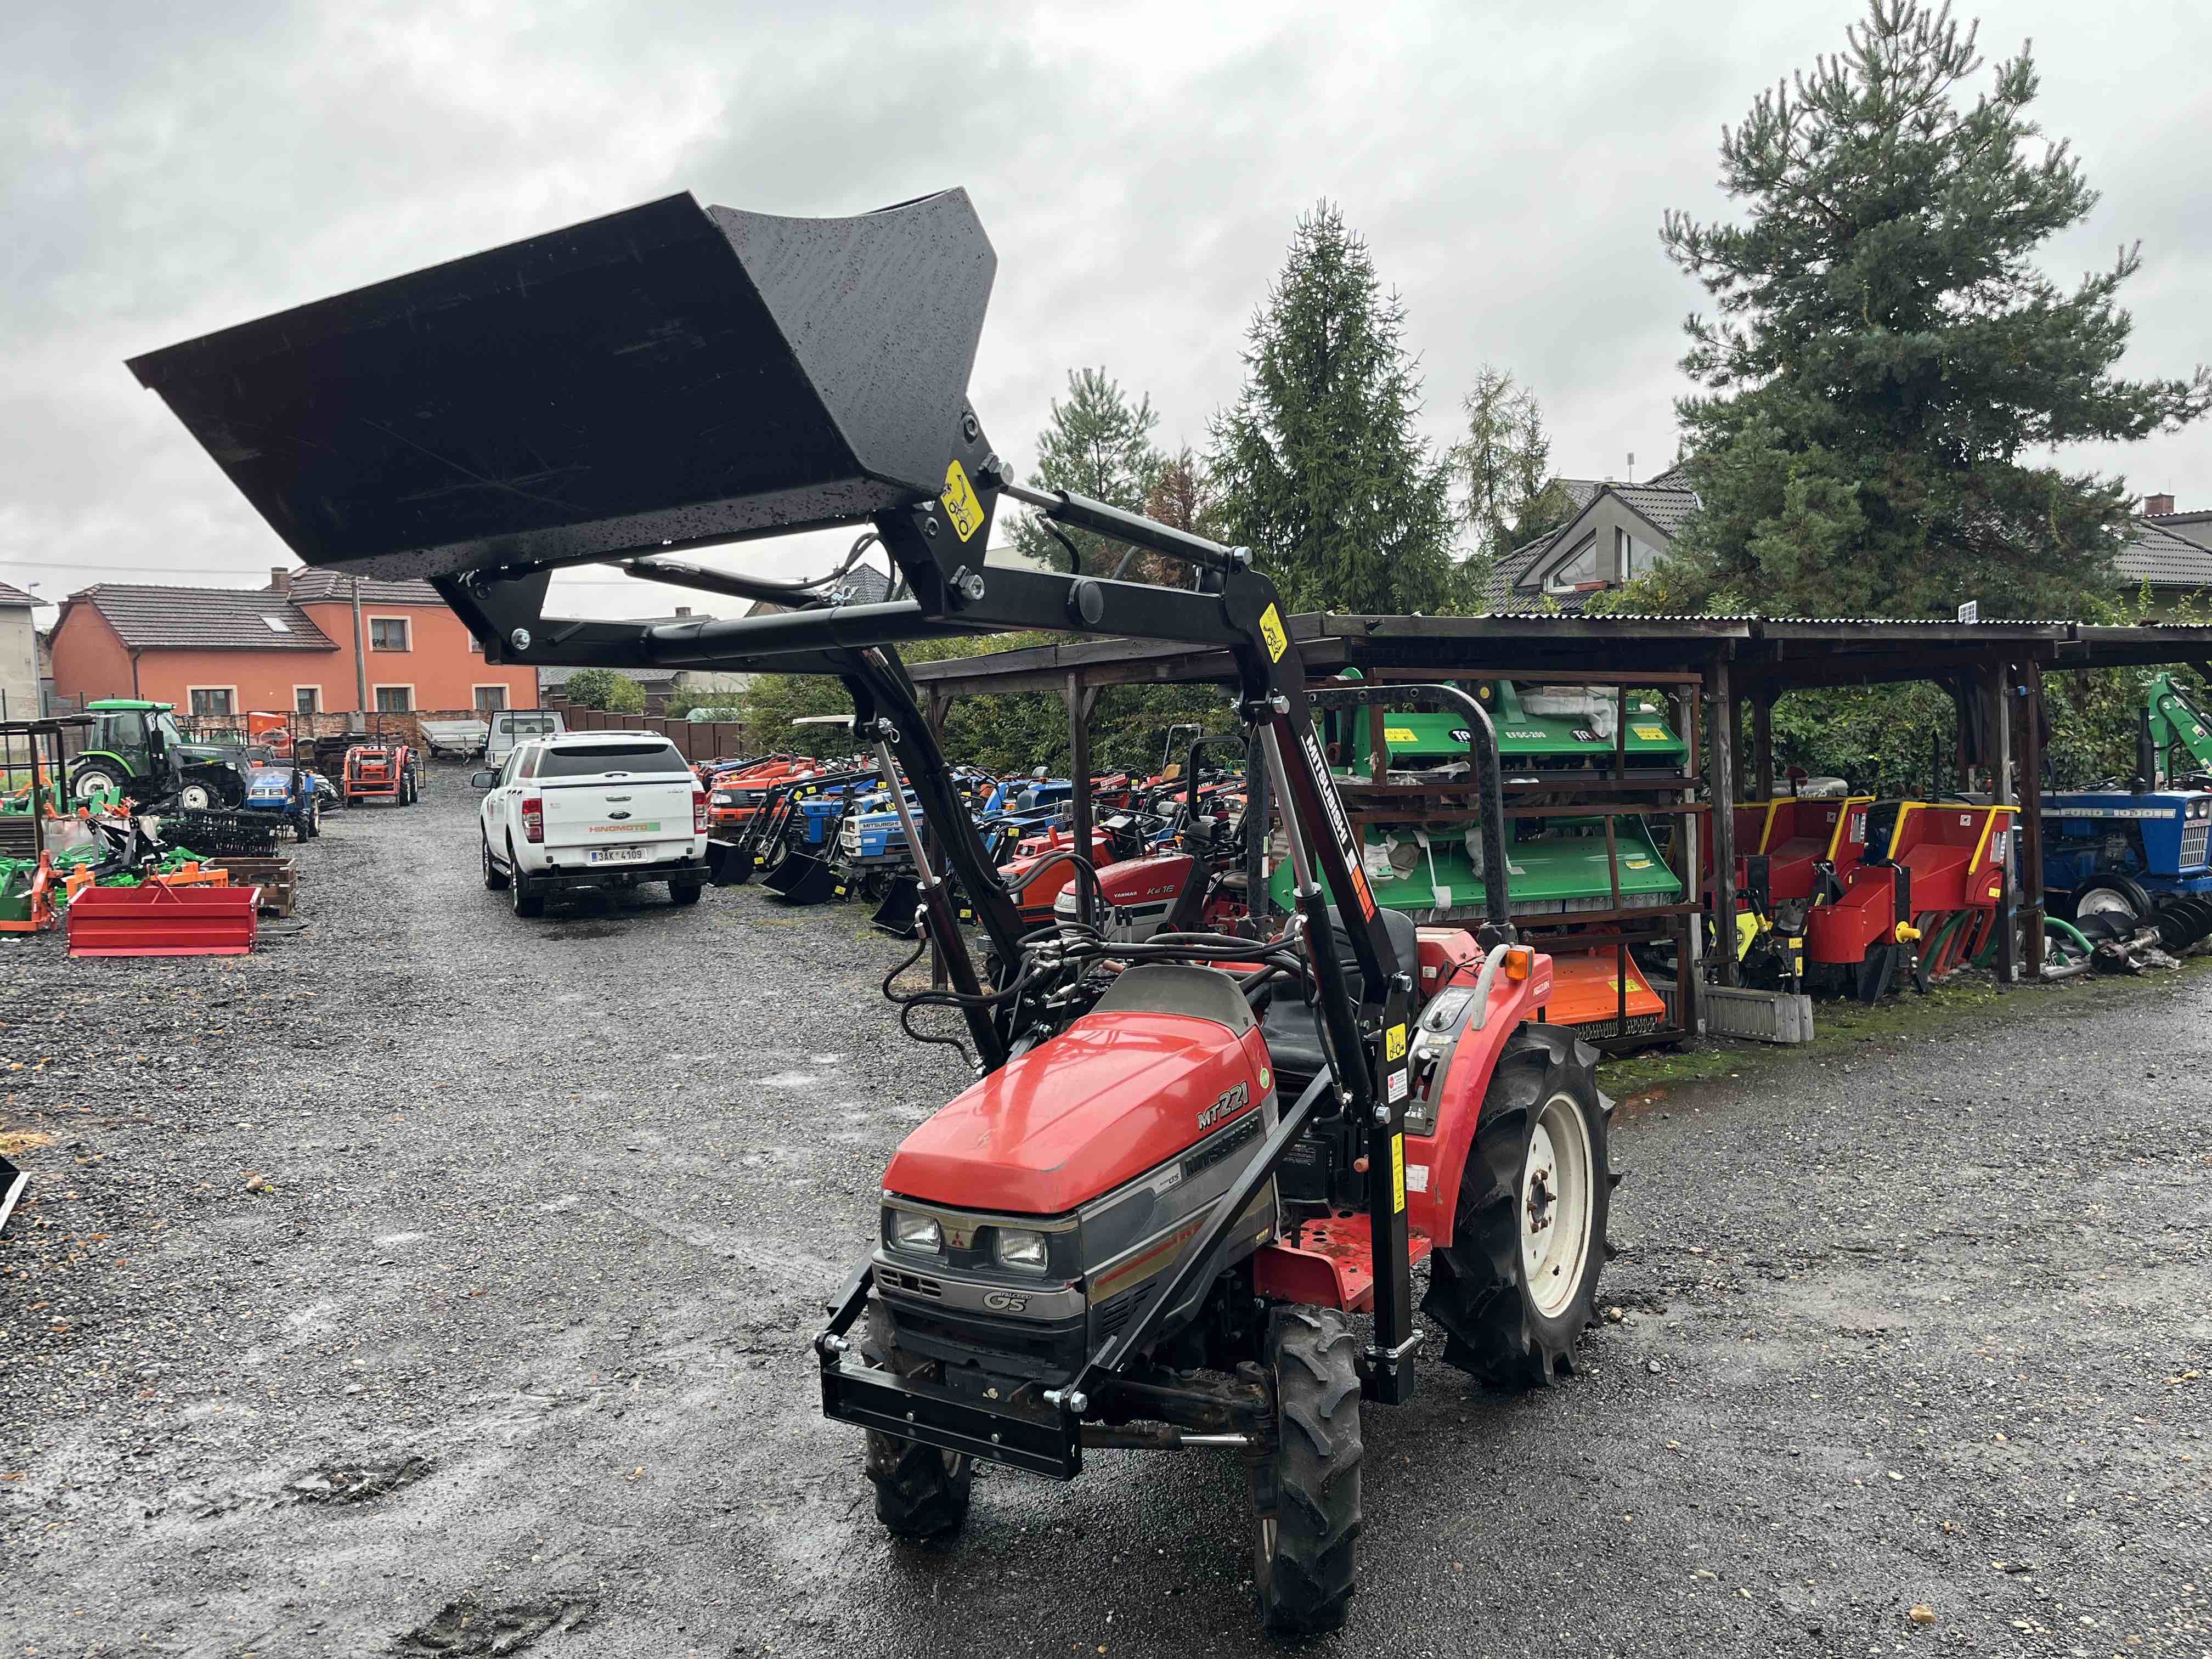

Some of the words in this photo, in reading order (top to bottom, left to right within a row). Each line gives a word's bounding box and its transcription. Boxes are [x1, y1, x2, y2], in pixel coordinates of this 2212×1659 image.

[1306, 733, 1348, 844] MITSUBISHI
[588, 825, 647, 833] HINOMOTO
[599, 851, 614, 861] 3AK
[621, 850, 642, 860] 4109
[1197, 1080, 1249, 1132] MT221
[983, 1291, 1026, 1312] GS
